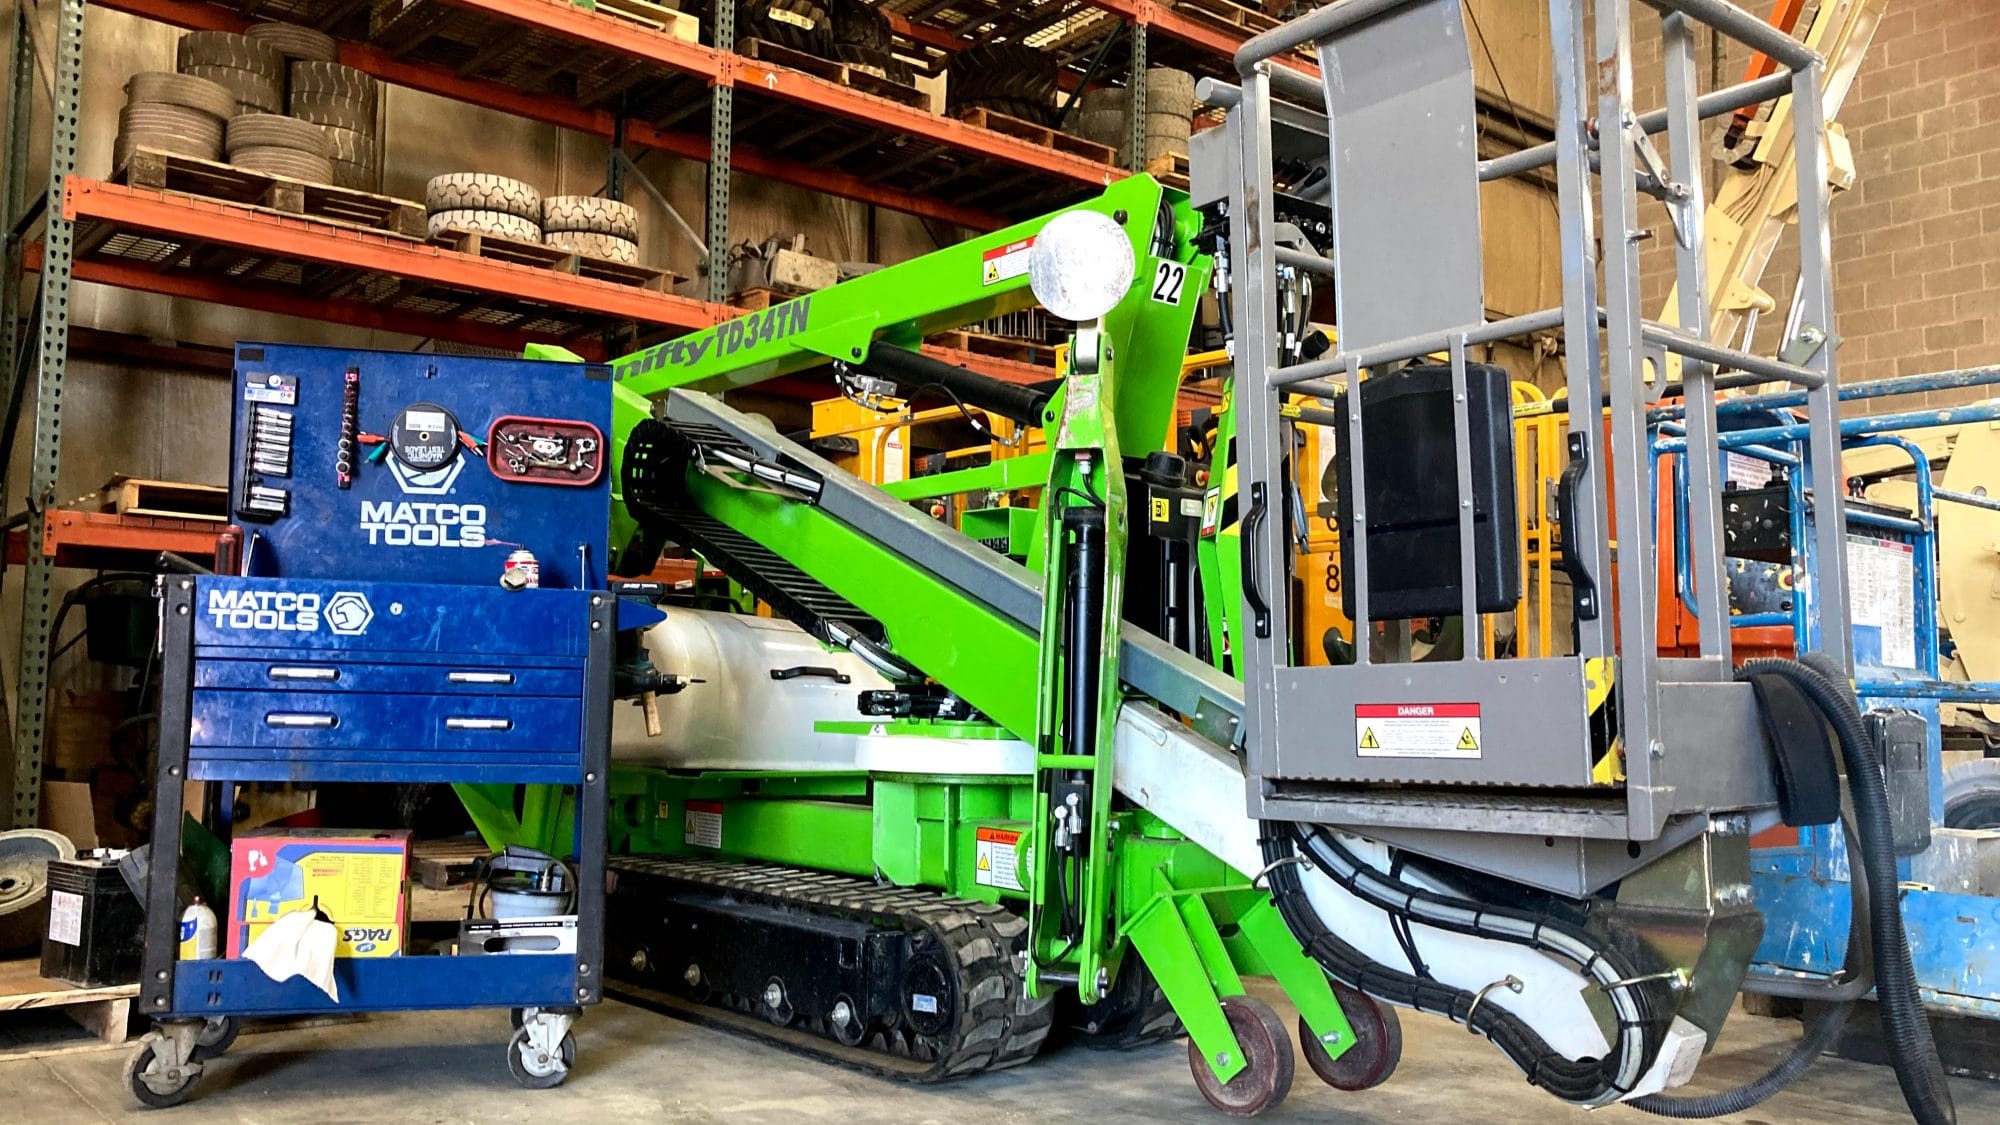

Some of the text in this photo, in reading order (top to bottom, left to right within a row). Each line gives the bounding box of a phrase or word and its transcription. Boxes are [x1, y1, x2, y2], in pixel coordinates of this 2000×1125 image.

[1153, 263, 1184, 304] 22
[614, 297, 811, 381] nifty TD34TN
[361, 501, 486, 526] MATCO
[360, 523, 486, 548] TOOLS
[208, 589, 320, 612] MATCO
[208, 608, 320, 631] TOOLS
[1397, 706, 1435, 716] DANGER
[342, 928, 392, 942] RAGS
